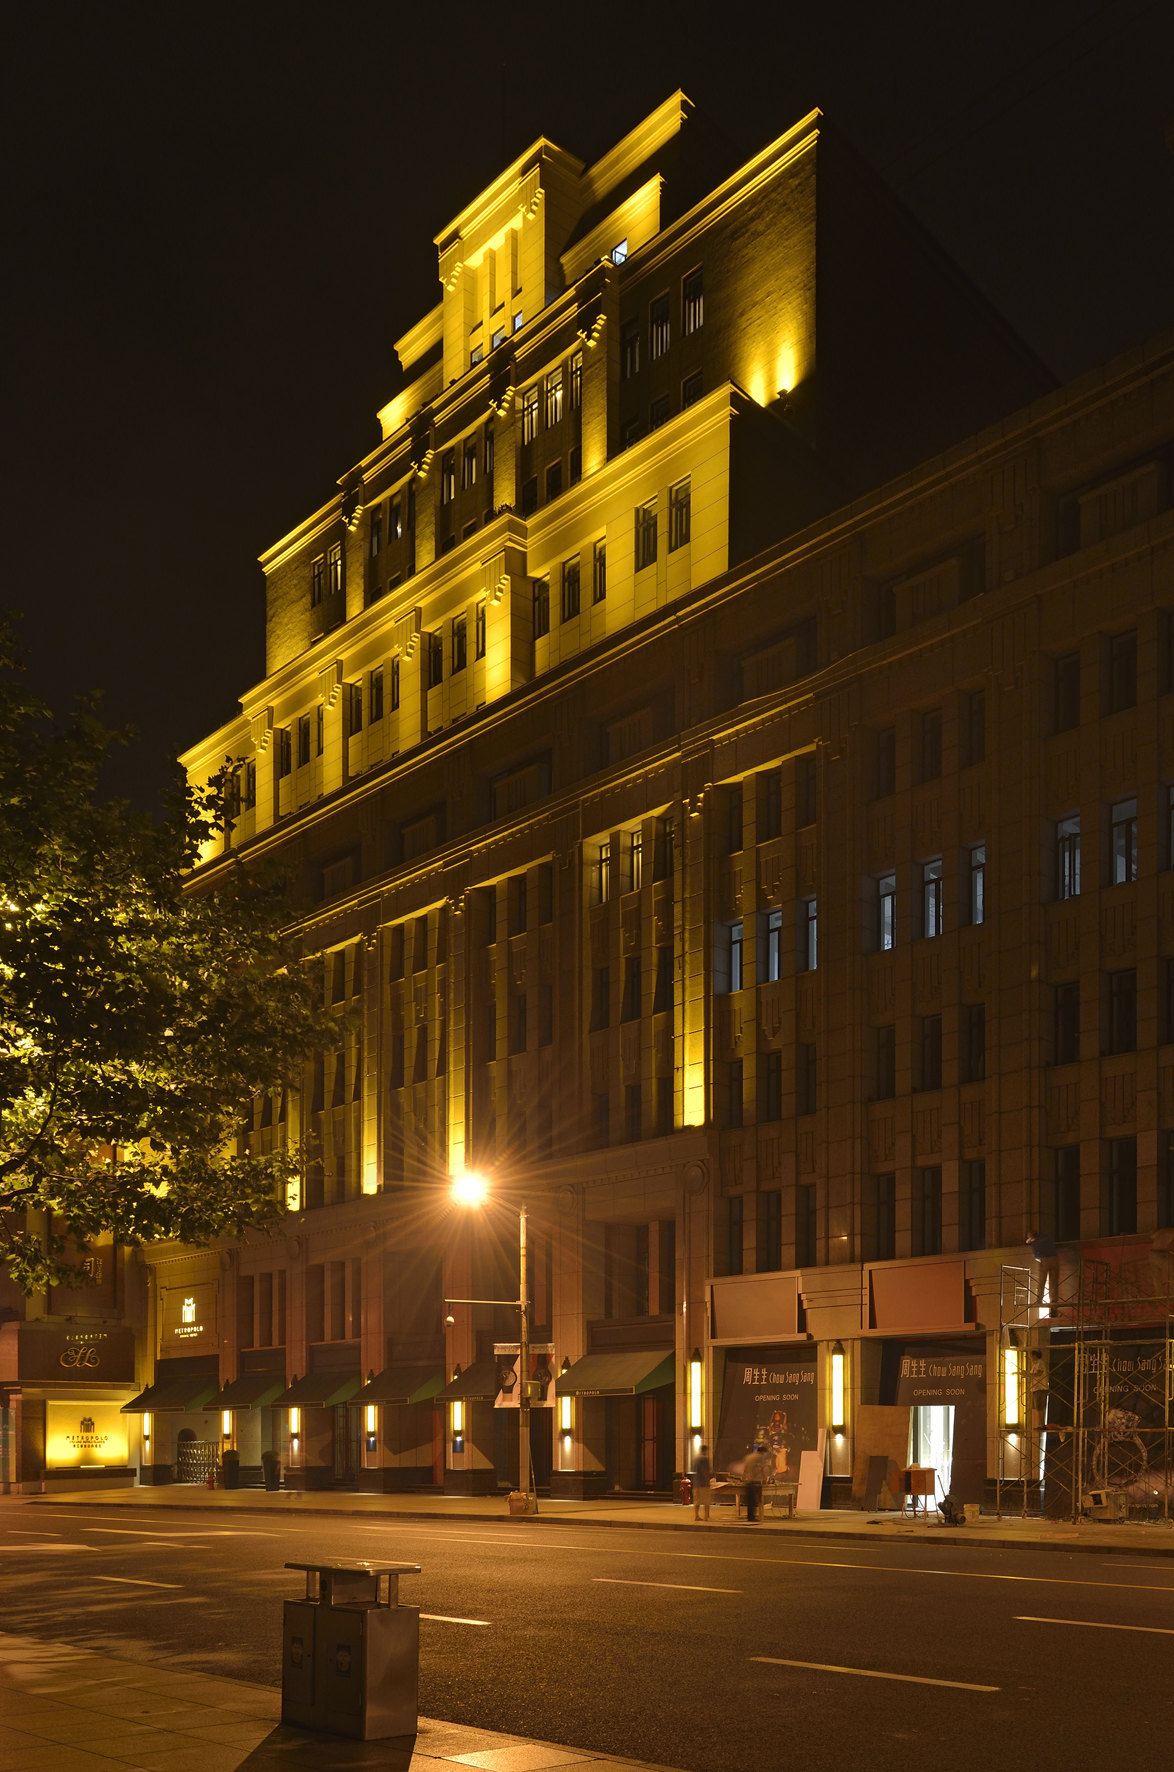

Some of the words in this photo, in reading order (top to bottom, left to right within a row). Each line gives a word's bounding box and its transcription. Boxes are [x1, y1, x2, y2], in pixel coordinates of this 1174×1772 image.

[742, 1367, 768, 1385] 周生生
[900, 1359, 926, 1378] 周生生
[929, 1364, 947, 1377] Chow
[948, 1363, 965, 1378] Sang
[966, 1362, 983, 1378] Sang
[769, 1372, 785, 1384] Chow
[786, 1371, 800, 1385] Sang
[801, 1370, 815, 1385] Sang
[754, 1394, 780, 1402] OPENING
[782, 1393, 799, 1401] SOON
[913, 1389, 943, 1397] OPENING
[945, 1388, 966, 1396] SOON
